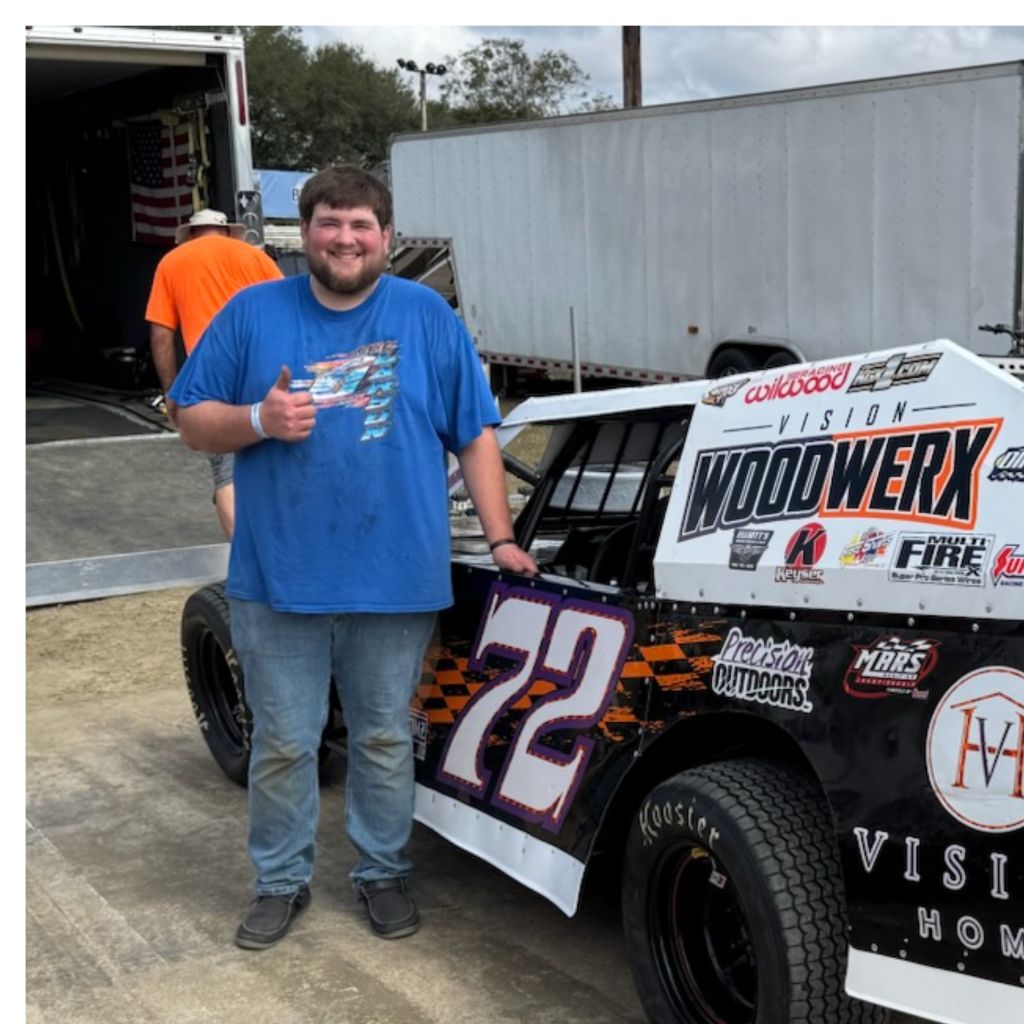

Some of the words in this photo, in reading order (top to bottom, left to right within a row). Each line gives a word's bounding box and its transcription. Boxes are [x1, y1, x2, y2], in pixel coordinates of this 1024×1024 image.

[778, 401, 907, 434] VISION
[680, 420, 1000, 538] WOODWERX
[896, 540, 986, 569] FIRE
[927, 535, 986, 546] MULTI
[775, 567, 825, 583] Keyser
[718, 628, 813, 676] Precision
[854, 649, 927, 674] MARS
[438, 588, 630, 825] 72
